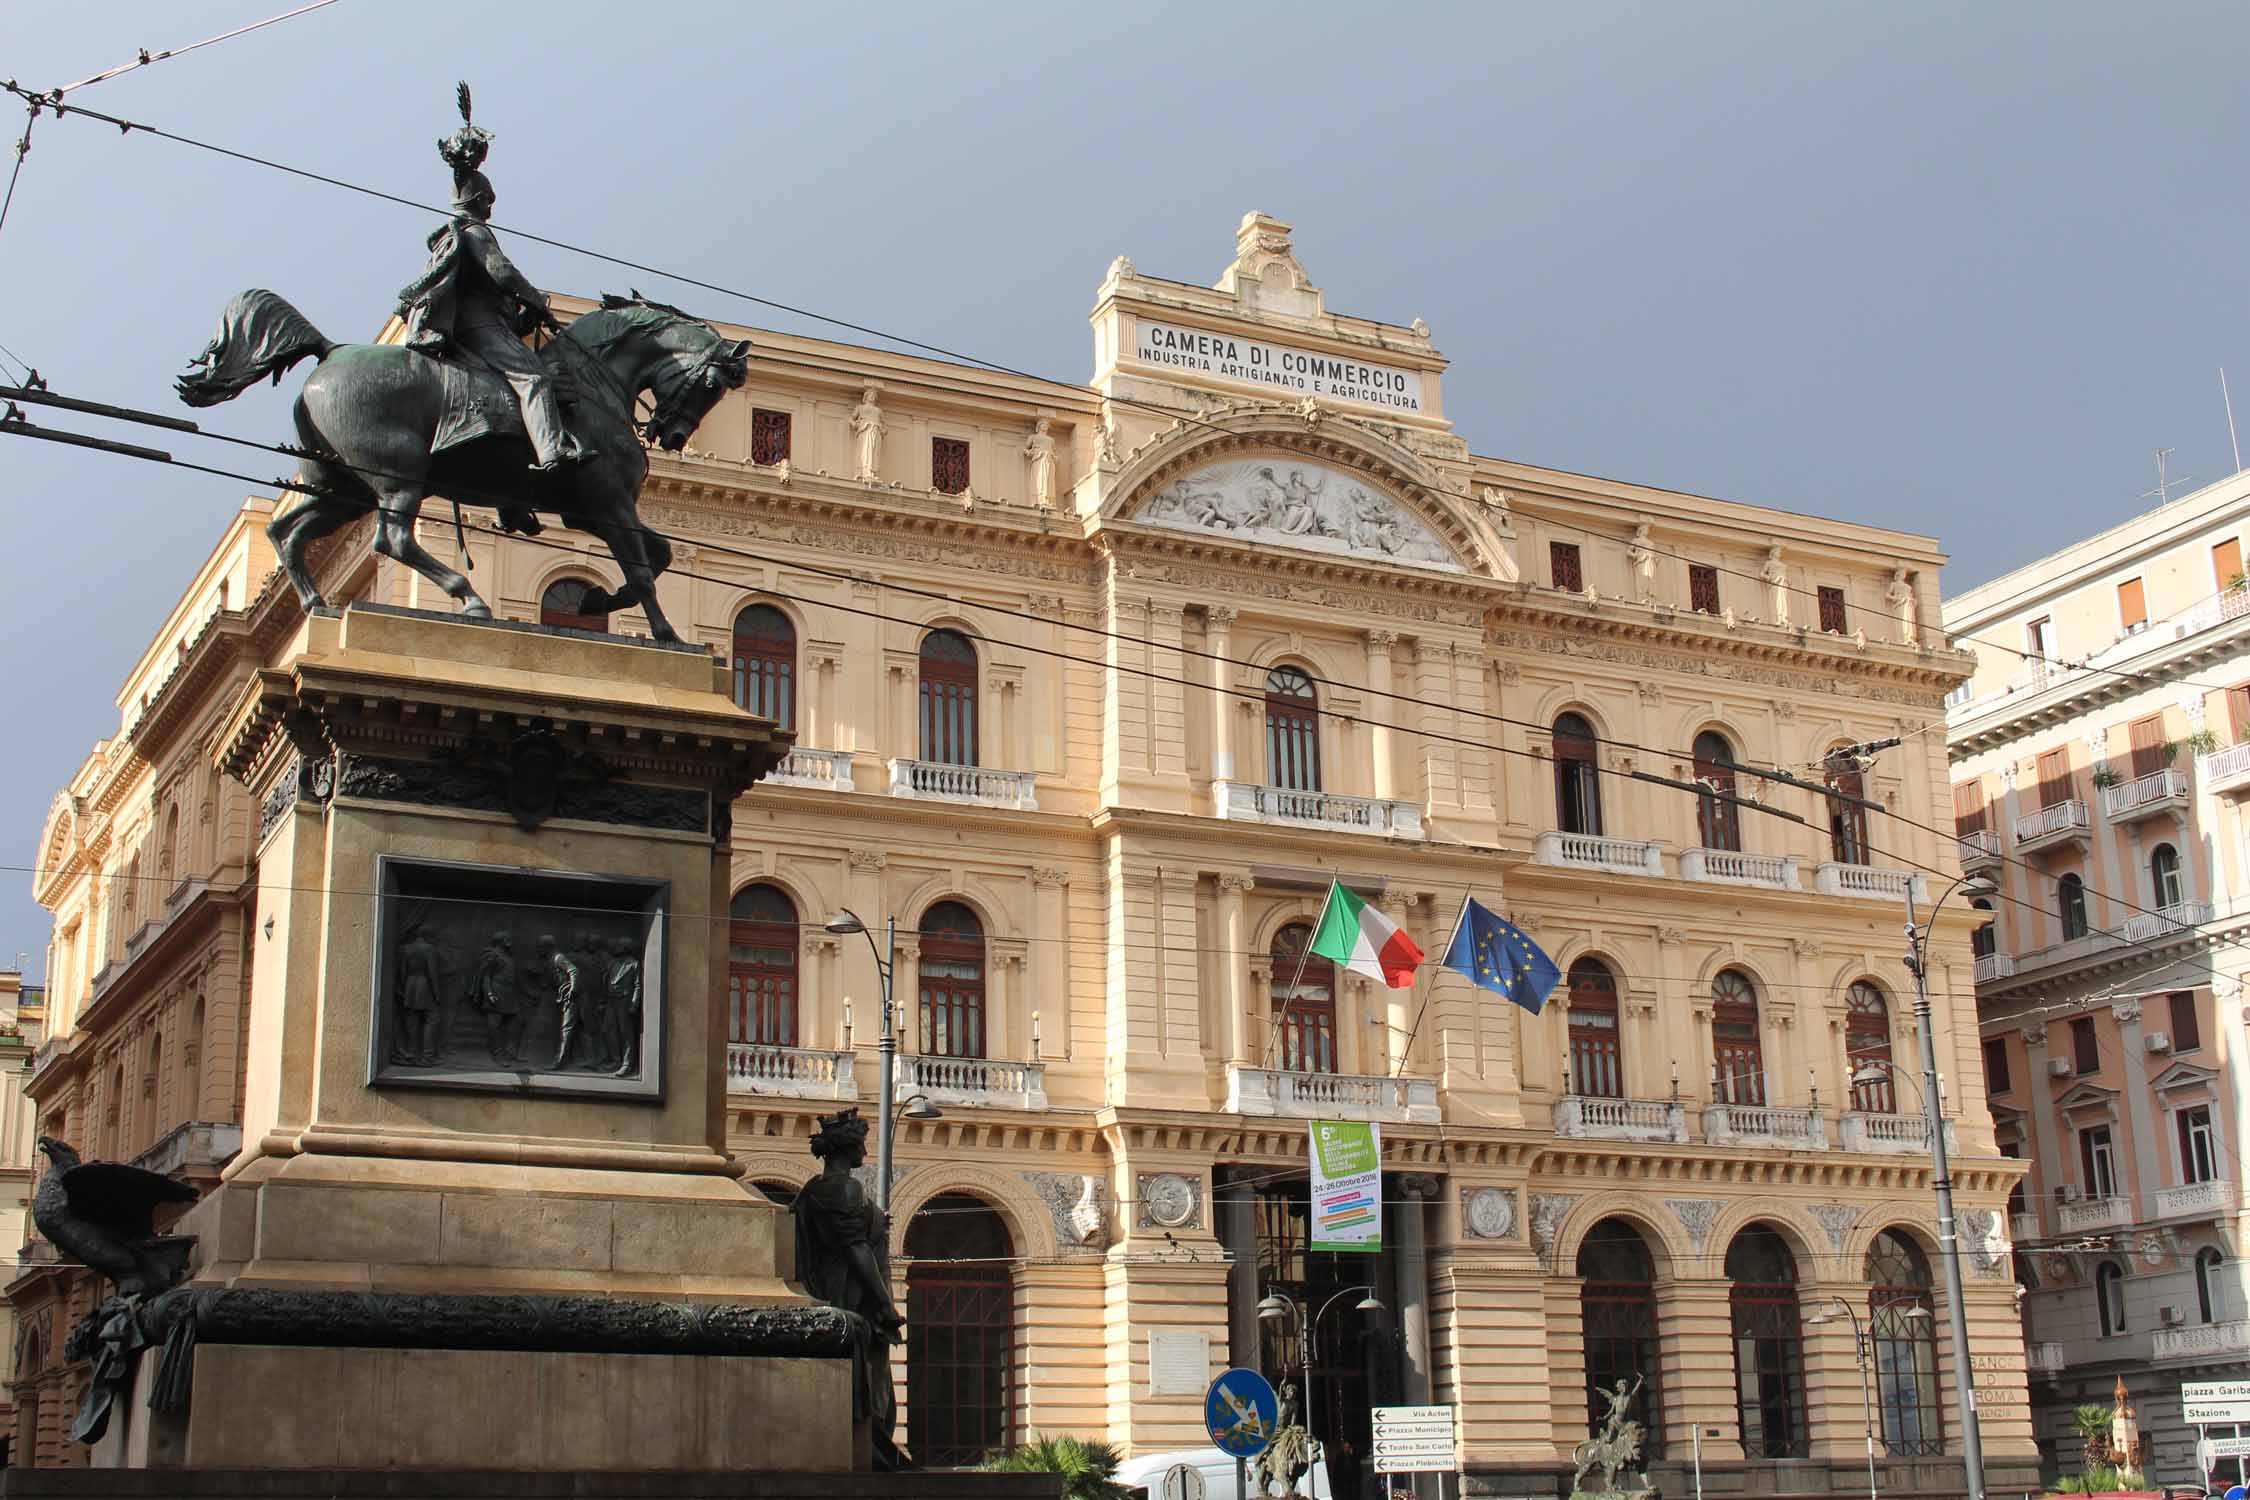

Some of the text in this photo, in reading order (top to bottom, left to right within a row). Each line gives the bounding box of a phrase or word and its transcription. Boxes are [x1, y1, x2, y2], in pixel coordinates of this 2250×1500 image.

[1151, 327, 1405, 392] CAMERA DI COMMERCIO
[1138, 347, 1419, 410] INDUSTRIA ARTIGIANATO E AGRICOLTURA
[1335, 1178, 1360, 1188] Ottobre
[1975, 1390, 2017, 1402] ROMA
[2184, 1387, 2214, 1397] piazza
[1428, 1409, 1450, 1417] Acton
[2188, 1408, 2231, 1418] Stazione
[1415, 1425, 1451, 1434] Municipio
[1432, 1442, 1452, 1450] Carlo
[1416, 1458, 1453, 1467] Plebiscito
